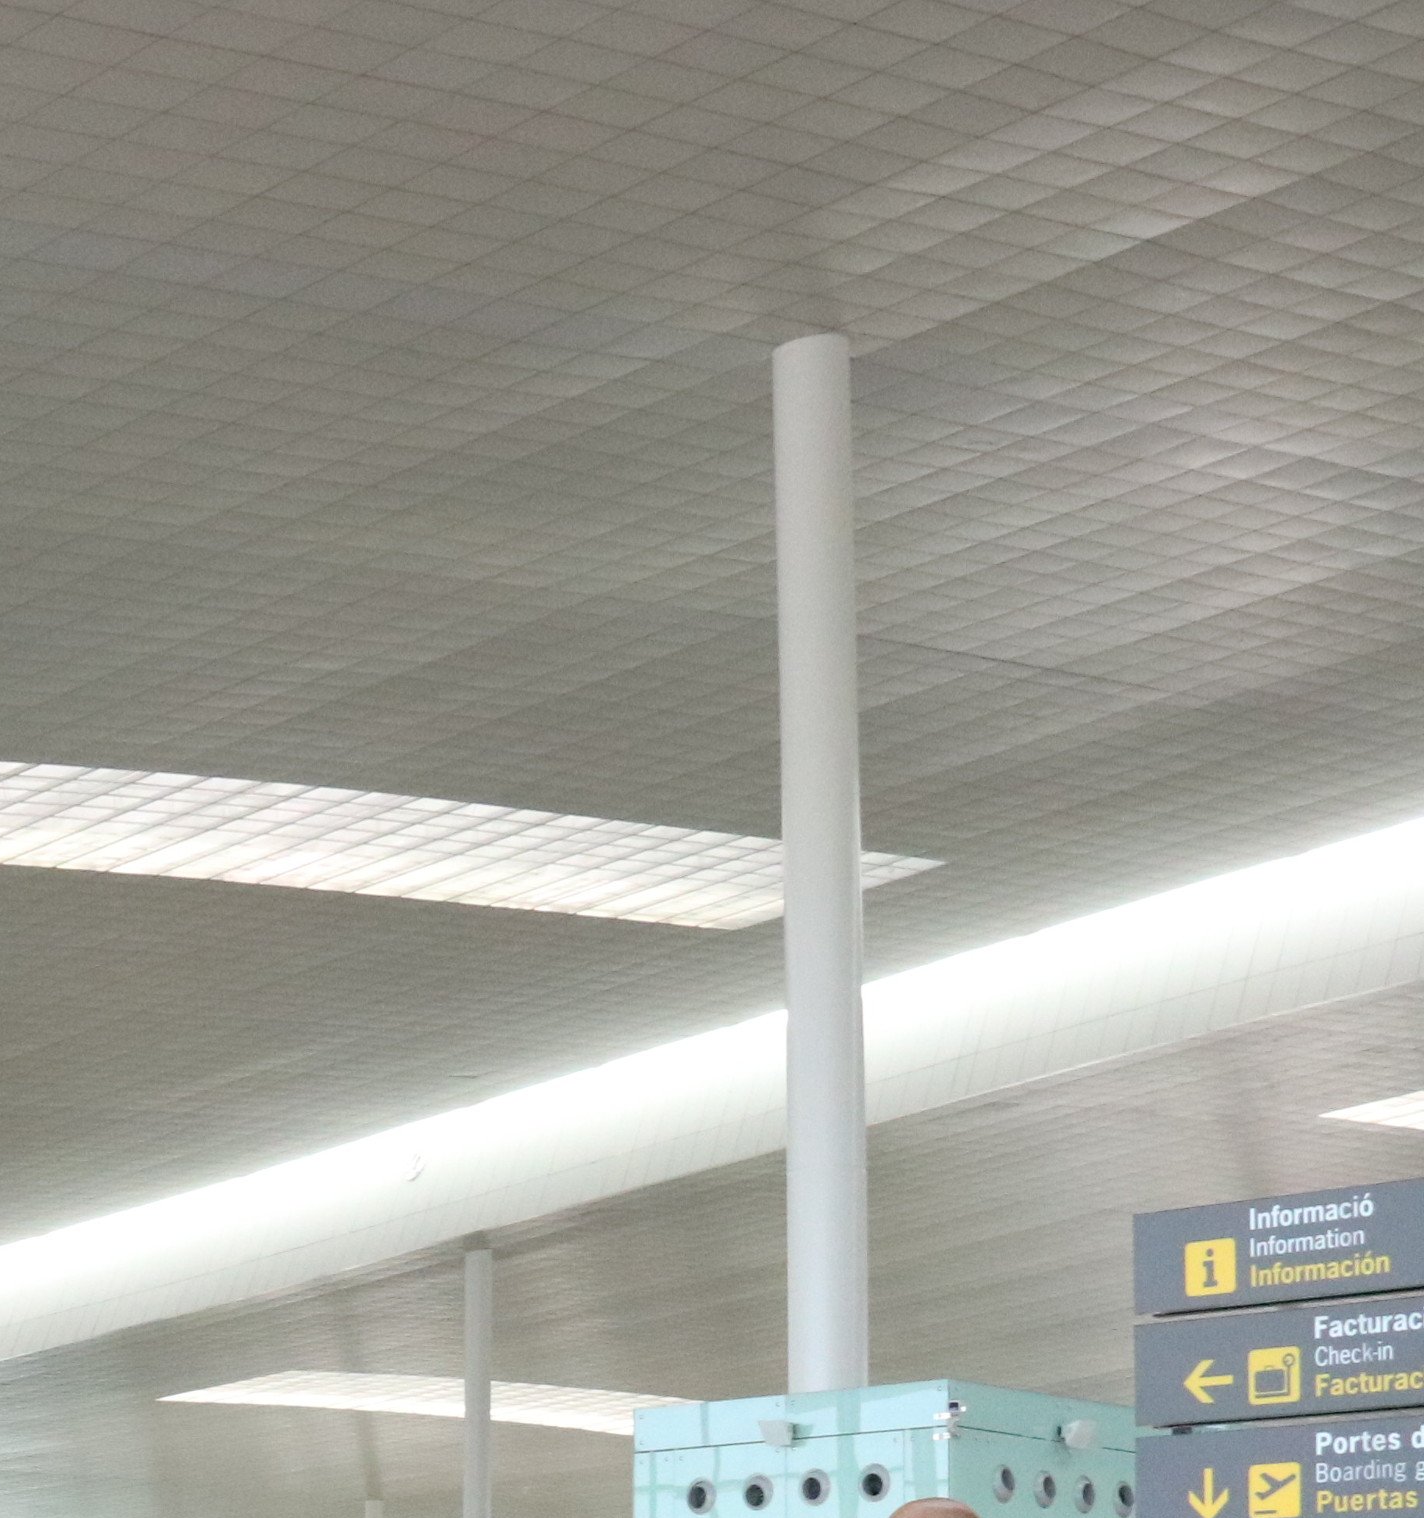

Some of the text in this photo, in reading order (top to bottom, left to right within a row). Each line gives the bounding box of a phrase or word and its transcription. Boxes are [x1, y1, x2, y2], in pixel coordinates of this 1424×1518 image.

[1249, 1193, 1374, 1230] Informació
[1249, 1226, 1365, 1258] Information
[1250, 1251, 1391, 1288] Información
[1314, 1310, 1424, 1340] Facturac
[1314, 1341, 1395, 1367] Check-in
[1315, 1370, 1424, 1398] Facturac
[1316, 1431, 1401, 1456] Portes
[1316, 1459, 1407, 1483] Boarding
[1316, 1488, 1419, 1514] Puertas
